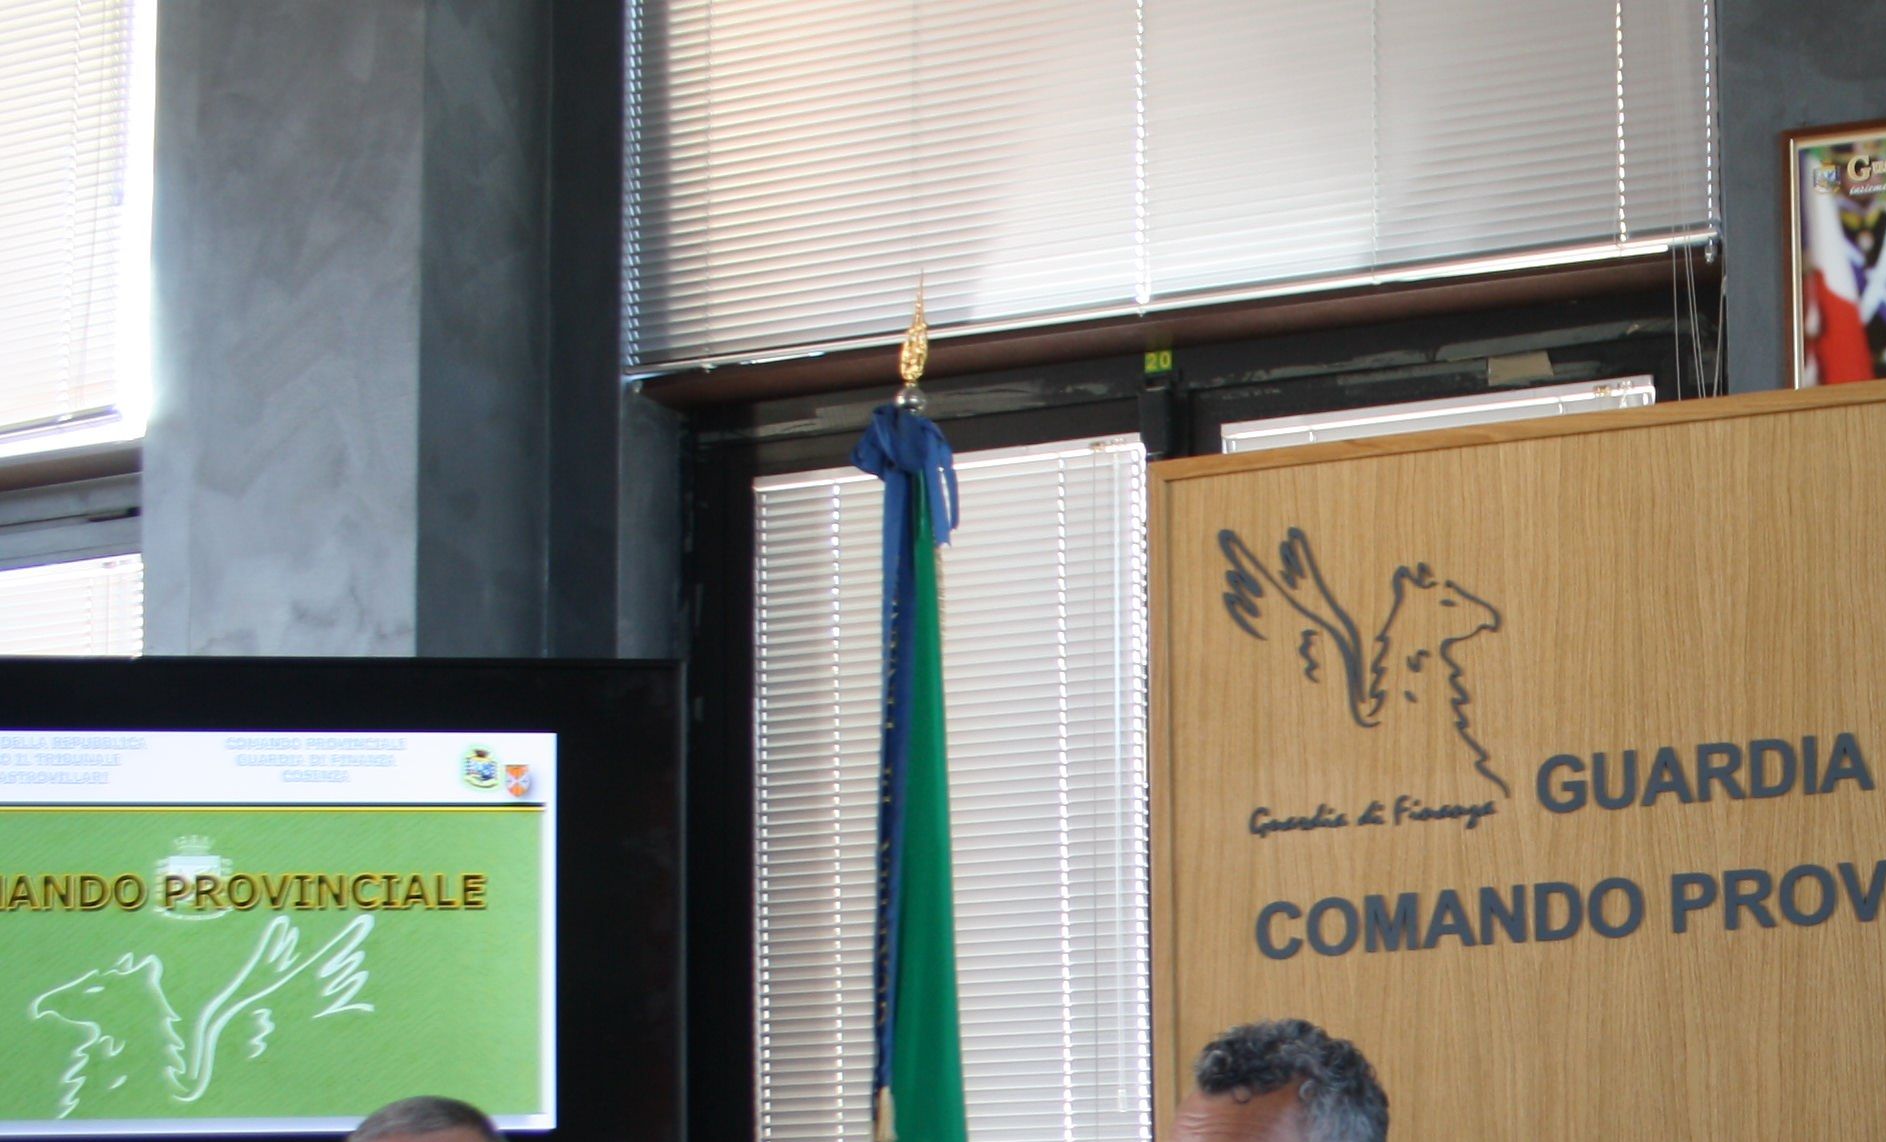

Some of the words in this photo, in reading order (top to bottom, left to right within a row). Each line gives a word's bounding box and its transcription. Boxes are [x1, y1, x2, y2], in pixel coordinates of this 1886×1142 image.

[1536, 732, 1875, 813] GUARDIA
[0, 872, 148, 912] ANDO
[160, 872, 488, 911] PROVINCIALE
[1255, 877, 1644, 961] COMANDO
